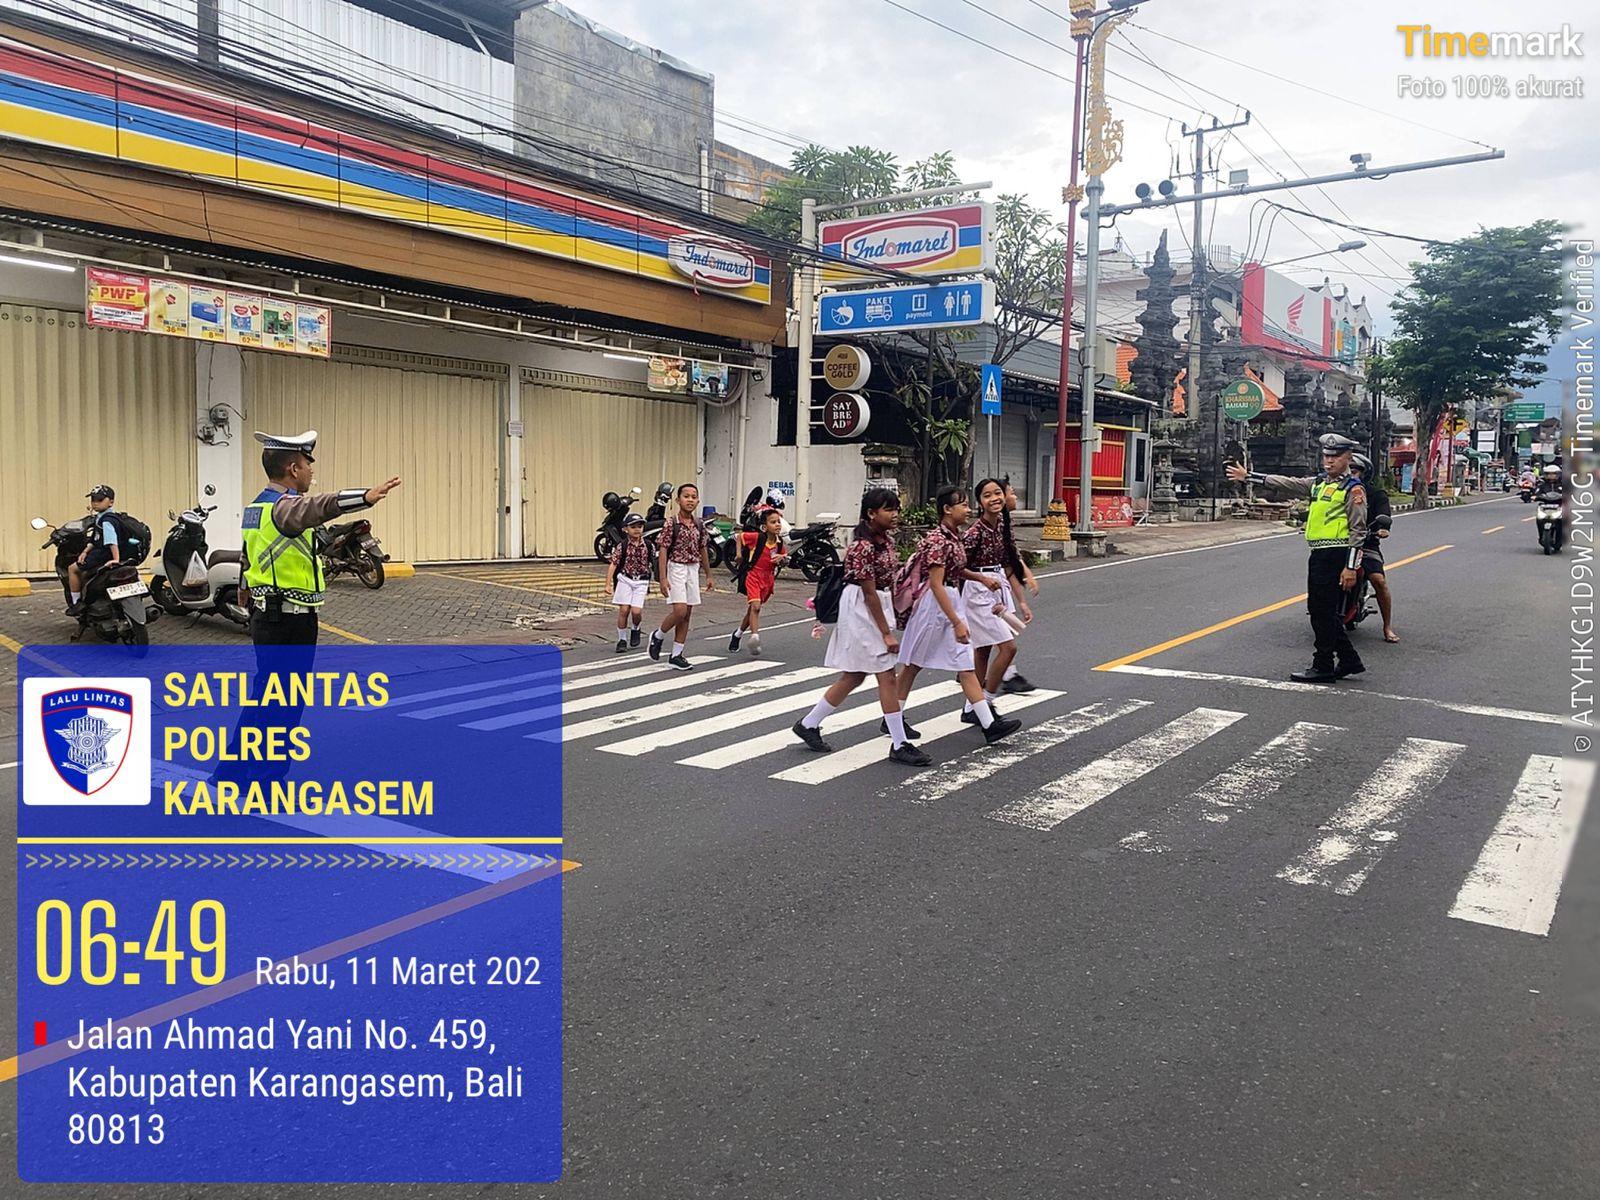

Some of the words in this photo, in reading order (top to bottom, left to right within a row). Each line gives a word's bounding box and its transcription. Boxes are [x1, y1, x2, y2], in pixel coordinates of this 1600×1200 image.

[853, 231, 948, 260] Indomaret
[683, 245, 750, 277] Indomaret
[100, 287, 136, 300] PWP
[866, 295, 893, 305] PAKET
[905, 310, 933, 320] payment
[827, 363, 857, 371] COFFEE
[832, 402, 852, 411] SAY
[832, 411, 852, 420] BRE
[832, 420, 846, 429] AD
[768, 481, 794, 489] BEBAS
